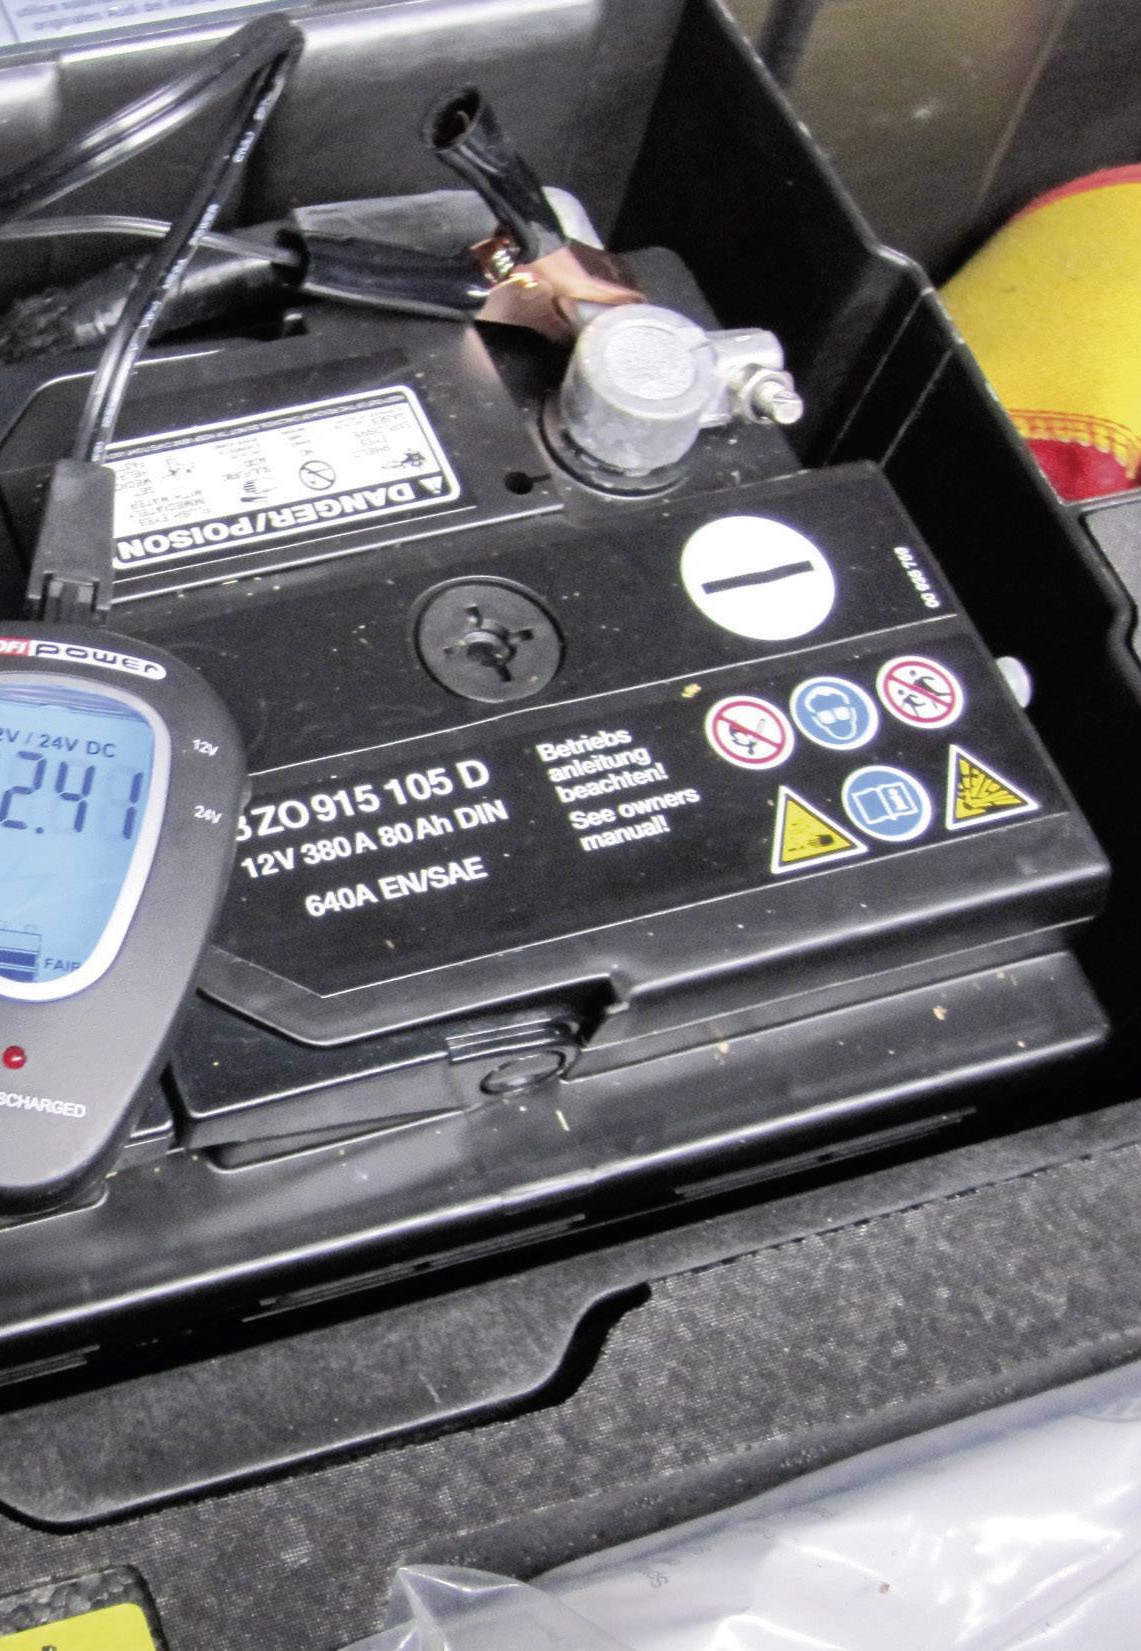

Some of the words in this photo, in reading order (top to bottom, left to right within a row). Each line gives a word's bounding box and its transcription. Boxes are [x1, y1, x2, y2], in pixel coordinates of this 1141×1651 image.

[118, 476, 416, 560] DANGER/POISON
[40, 734, 78, 751] 24V
[86, 740, 117, 758] DC
[193, 739, 219, 756] 12V
[535, 726, 633, 763] Betriebs
[547, 744, 651, 784] anleitung
[316, 784, 381, 824] 915
[384, 766, 454, 806] 105
[456, 759, 491, 790] D
[557, 762, 668, 804] beachten!
[194, 805, 222, 824] 24V
[568, 805, 617, 831] See
[621, 786, 701, 819] owners
[240, 845, 295, 879] 12V
[457, 798, 509, 830] DIN
[579, 814, 671, 852] manual!
[304, 883, 379, 917] 640A
[378, 856, 489, 900] EN/SAE
